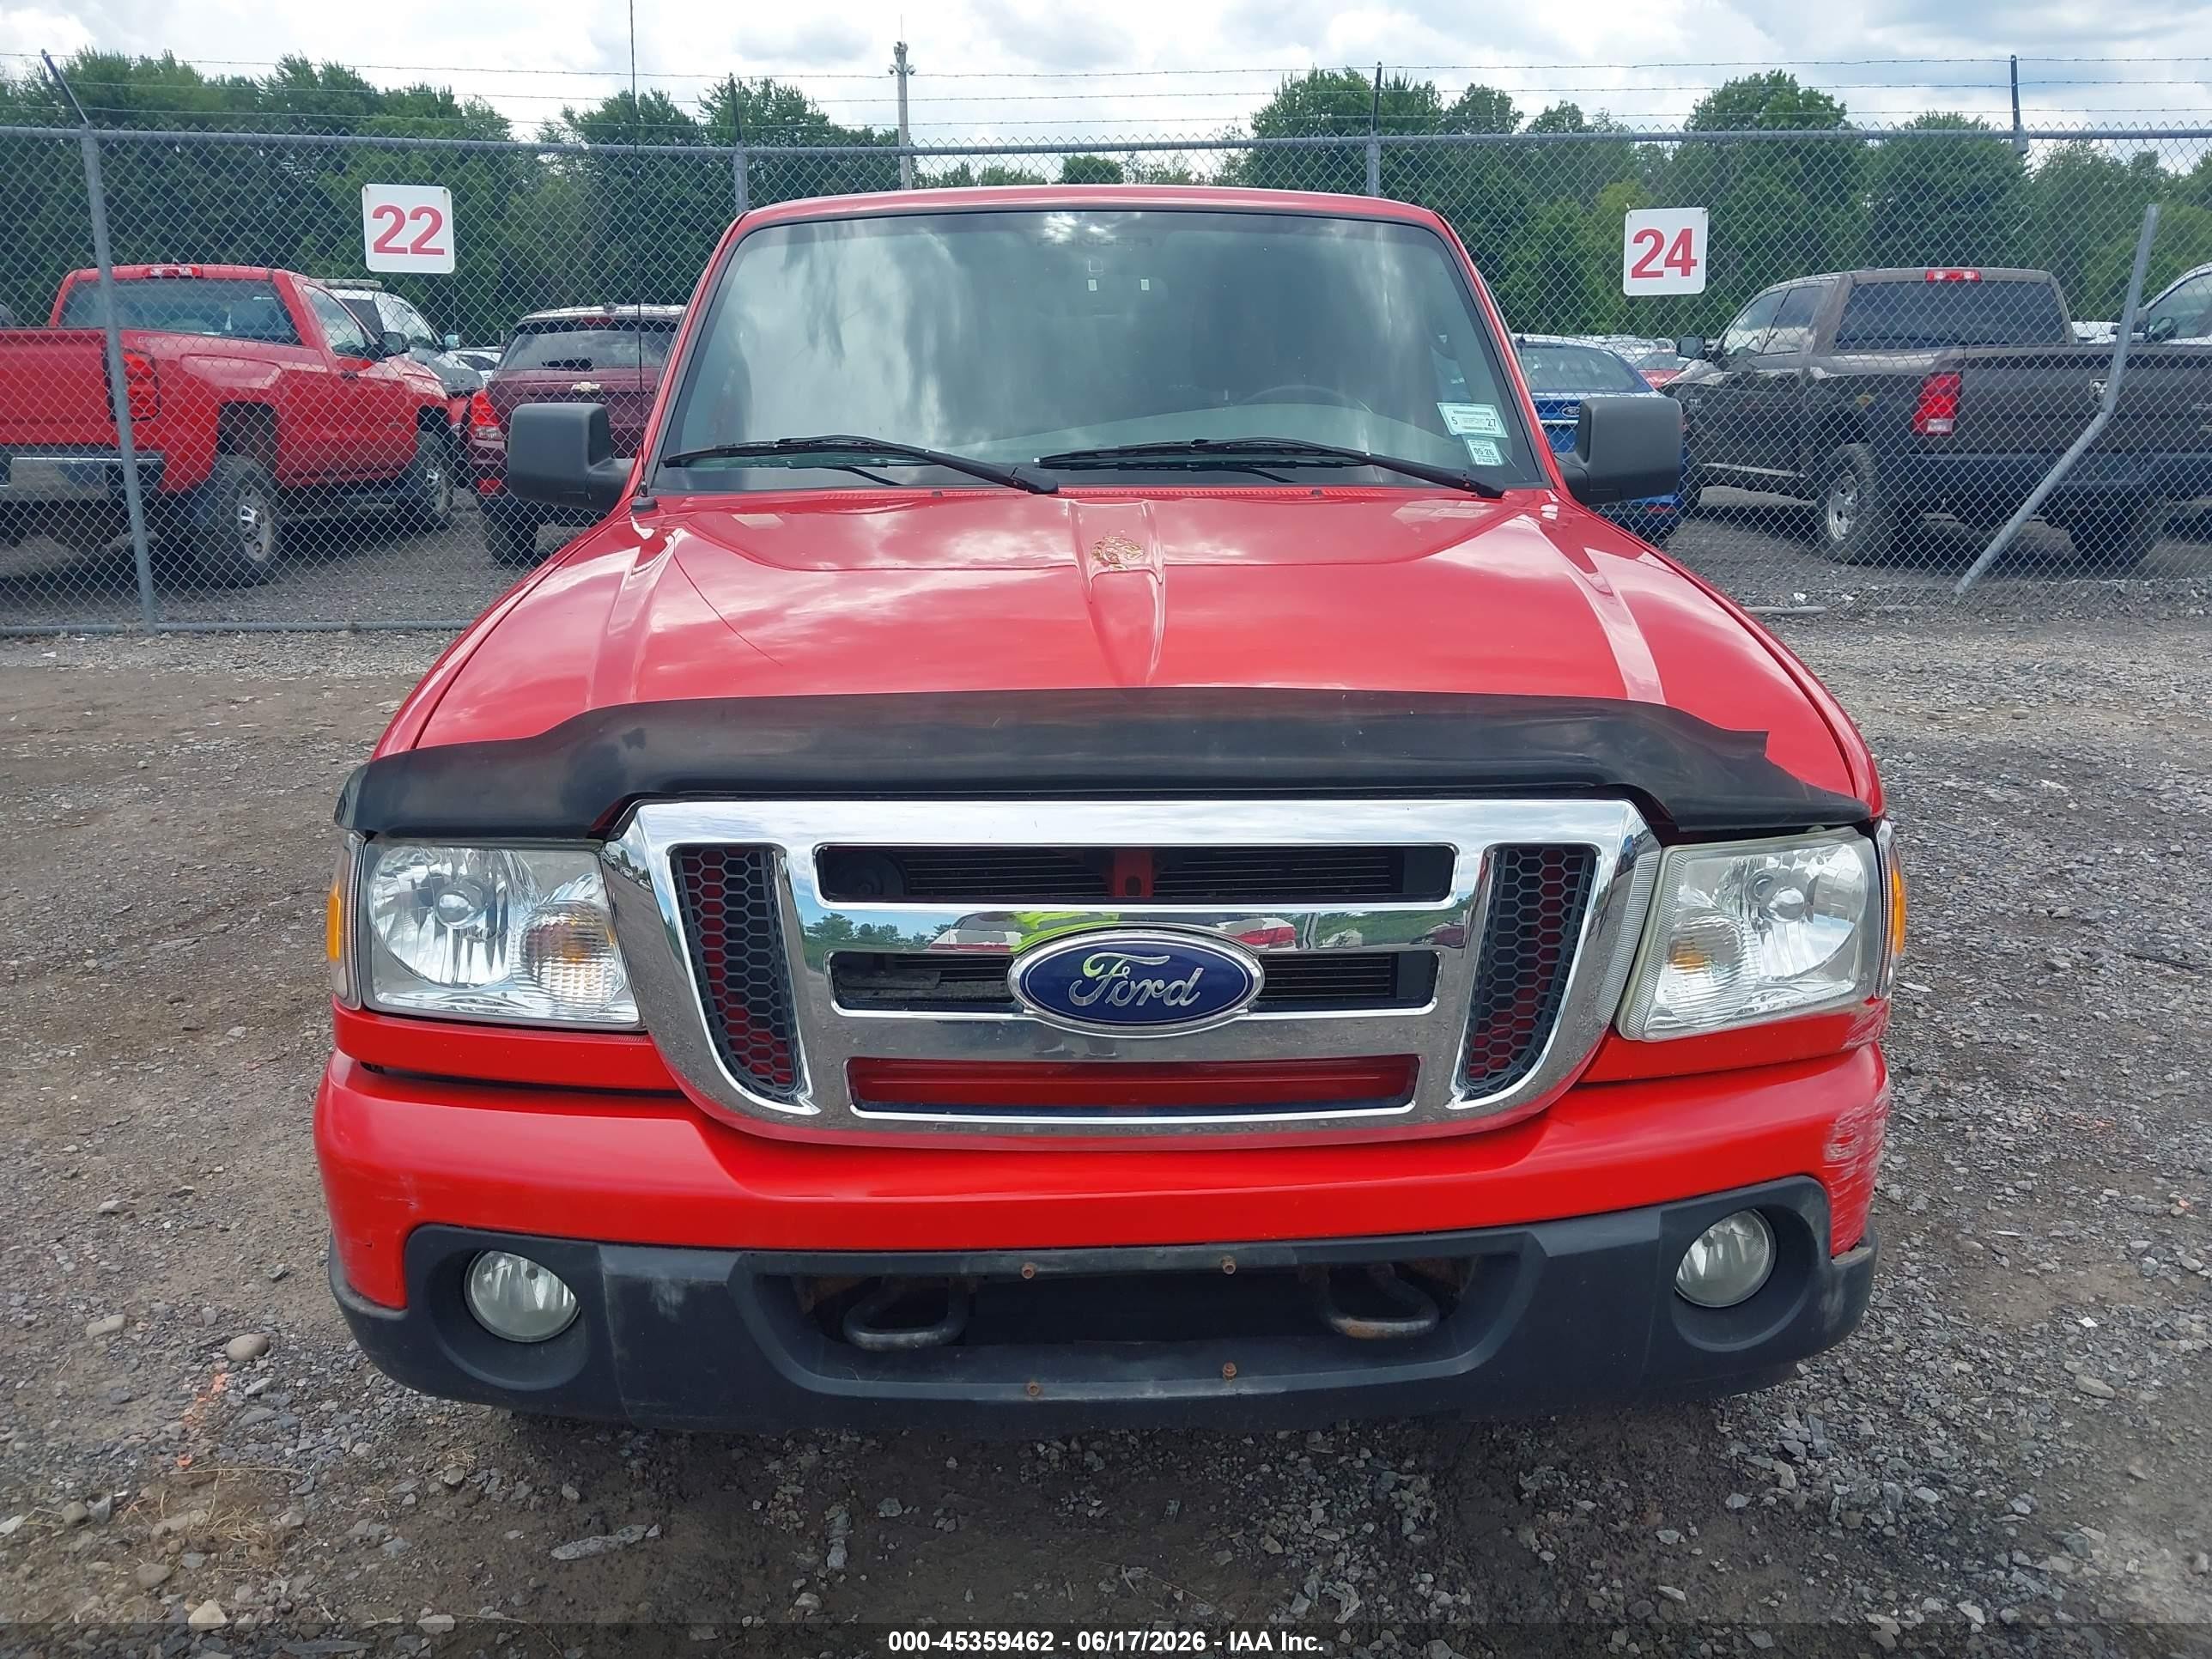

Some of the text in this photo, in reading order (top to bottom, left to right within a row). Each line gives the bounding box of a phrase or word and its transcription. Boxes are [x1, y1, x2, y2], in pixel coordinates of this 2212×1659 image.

[373, 205, 445, 255] 22
[1631, 228, 1698, 279] 24
[1451, 416, 1458, 425] 5
[1486, 418, 1496, 428] 27
[1068, 952, 1204, 1006] Ford
